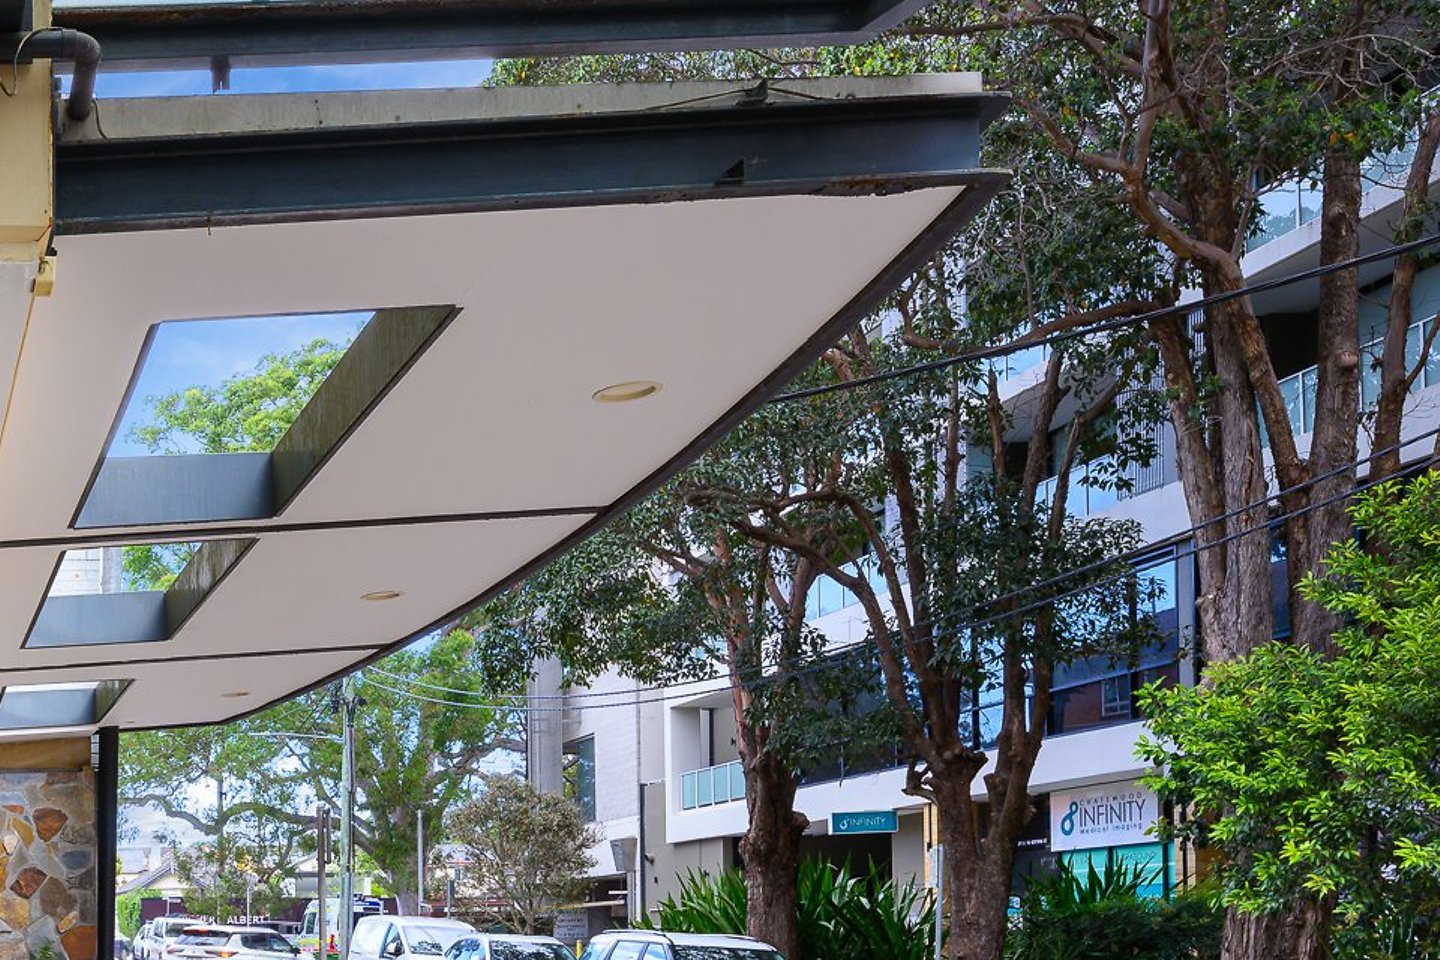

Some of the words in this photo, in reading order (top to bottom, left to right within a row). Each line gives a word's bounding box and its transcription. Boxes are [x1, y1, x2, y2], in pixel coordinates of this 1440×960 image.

[1079, 799, 1145, 828] INFINITY
[849, 815, 887, 827] INFINITY
[1079, 825, 1109, 835] Medical
[227, 915, 265, 925] ALBERT
